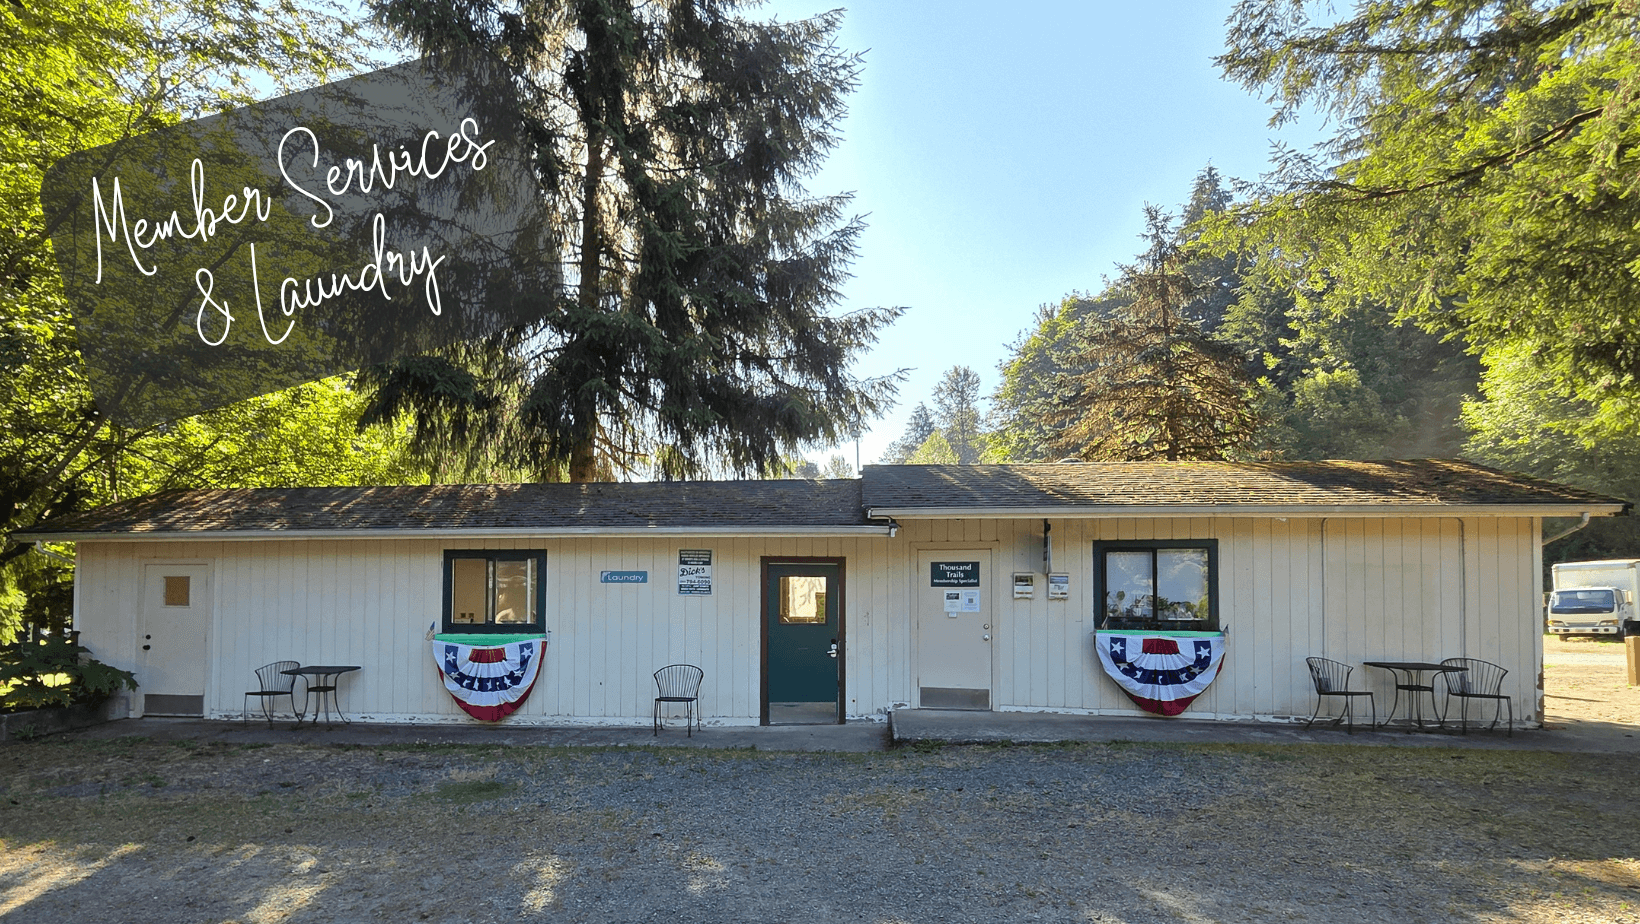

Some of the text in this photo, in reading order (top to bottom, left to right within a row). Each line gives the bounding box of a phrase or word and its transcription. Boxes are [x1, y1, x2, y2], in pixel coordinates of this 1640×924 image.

[939, 563, 972, 571] Thousand
[679, 567, 706, 577] Dick's
[607, 574, 644, 582] Laundry
